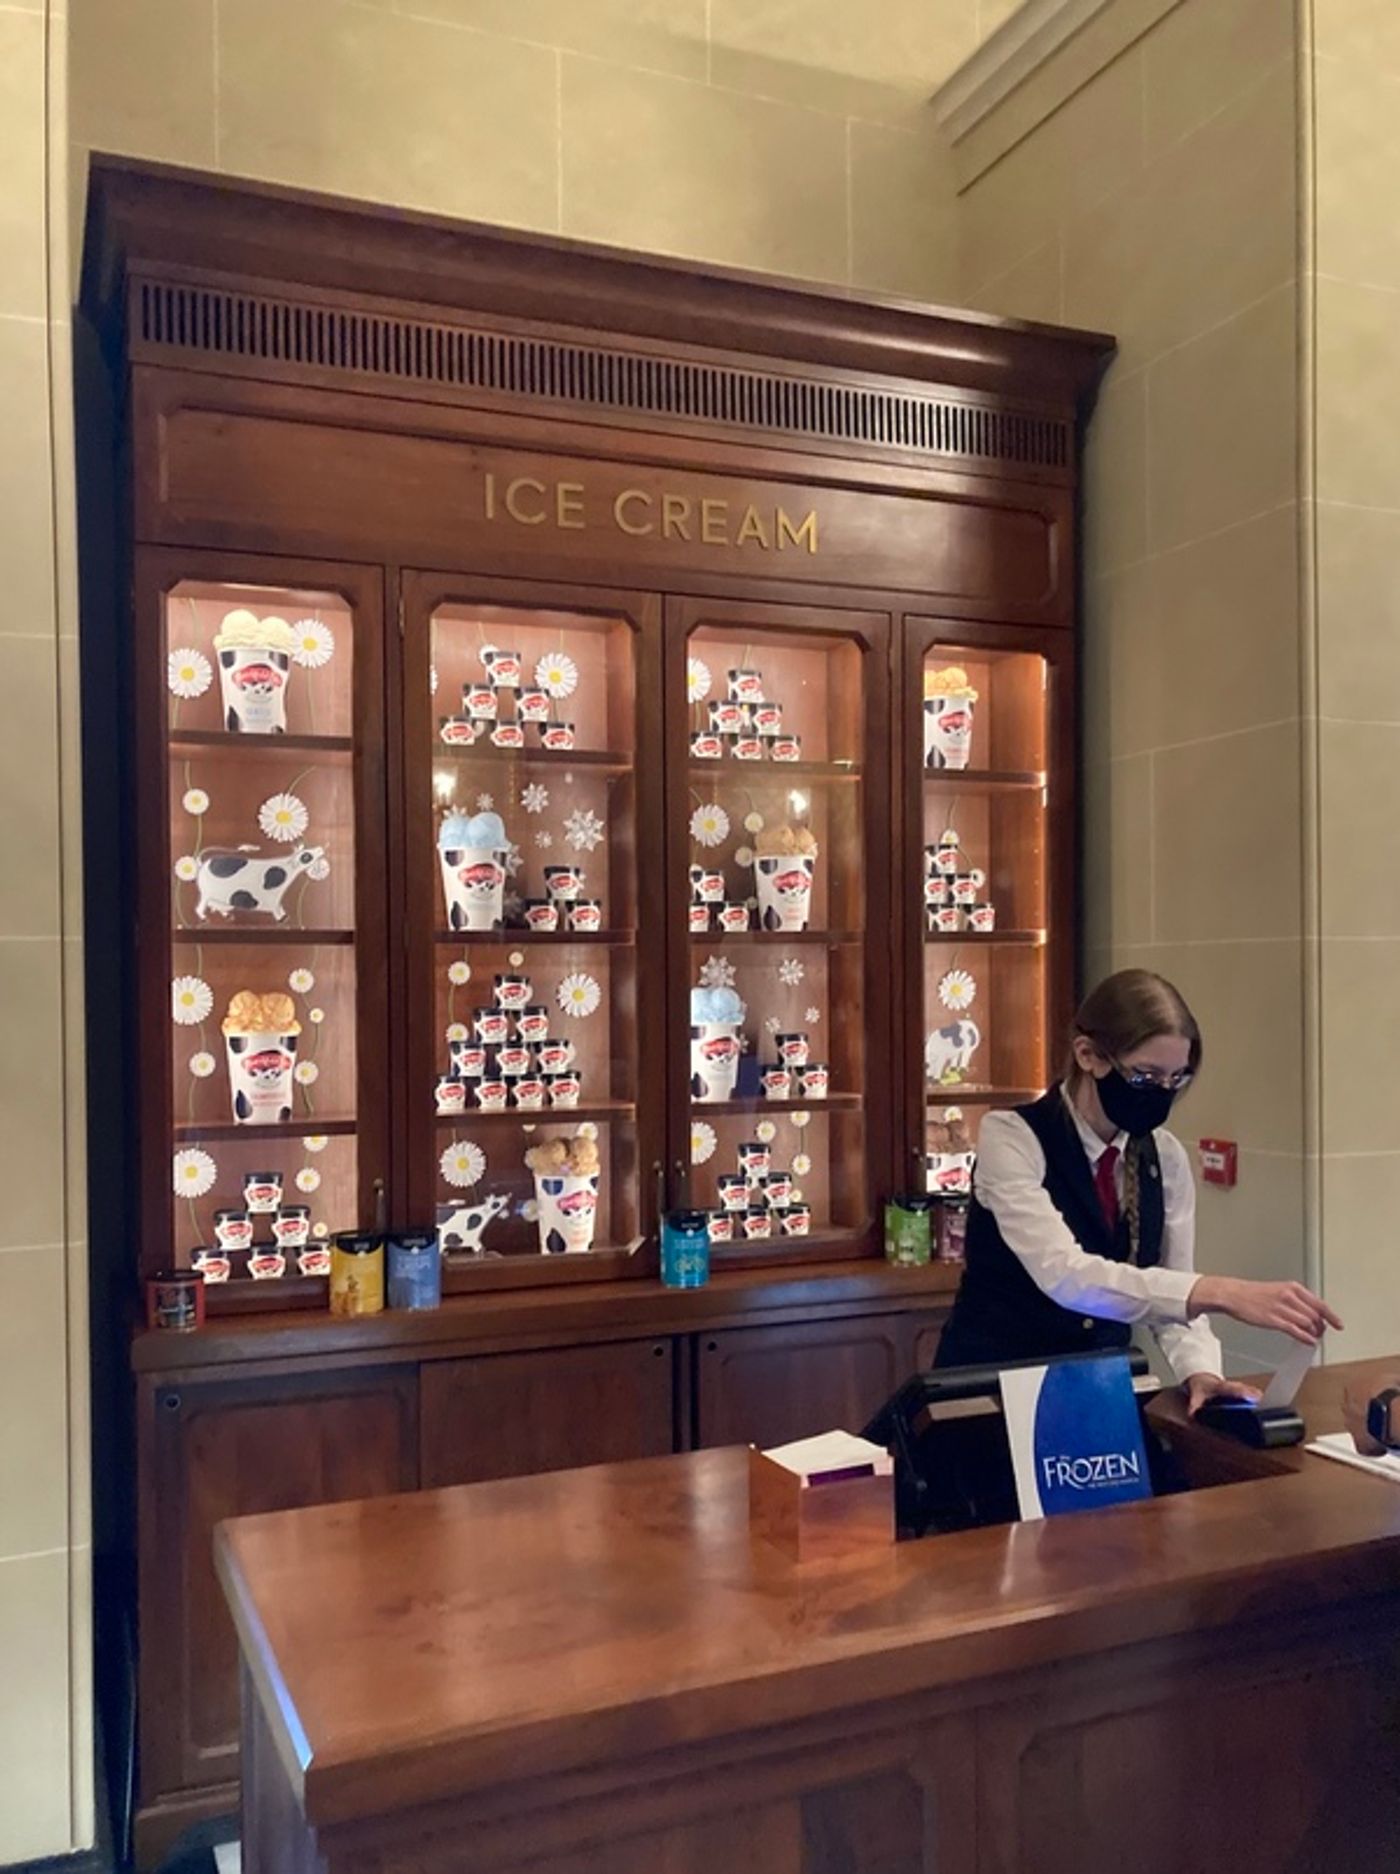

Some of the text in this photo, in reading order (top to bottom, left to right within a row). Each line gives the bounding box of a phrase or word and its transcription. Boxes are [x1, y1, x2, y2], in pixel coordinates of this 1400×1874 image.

[485, 473, 819, 553] ICE CREAM
[1043, 1450, 1139, 1490] FROZEN
